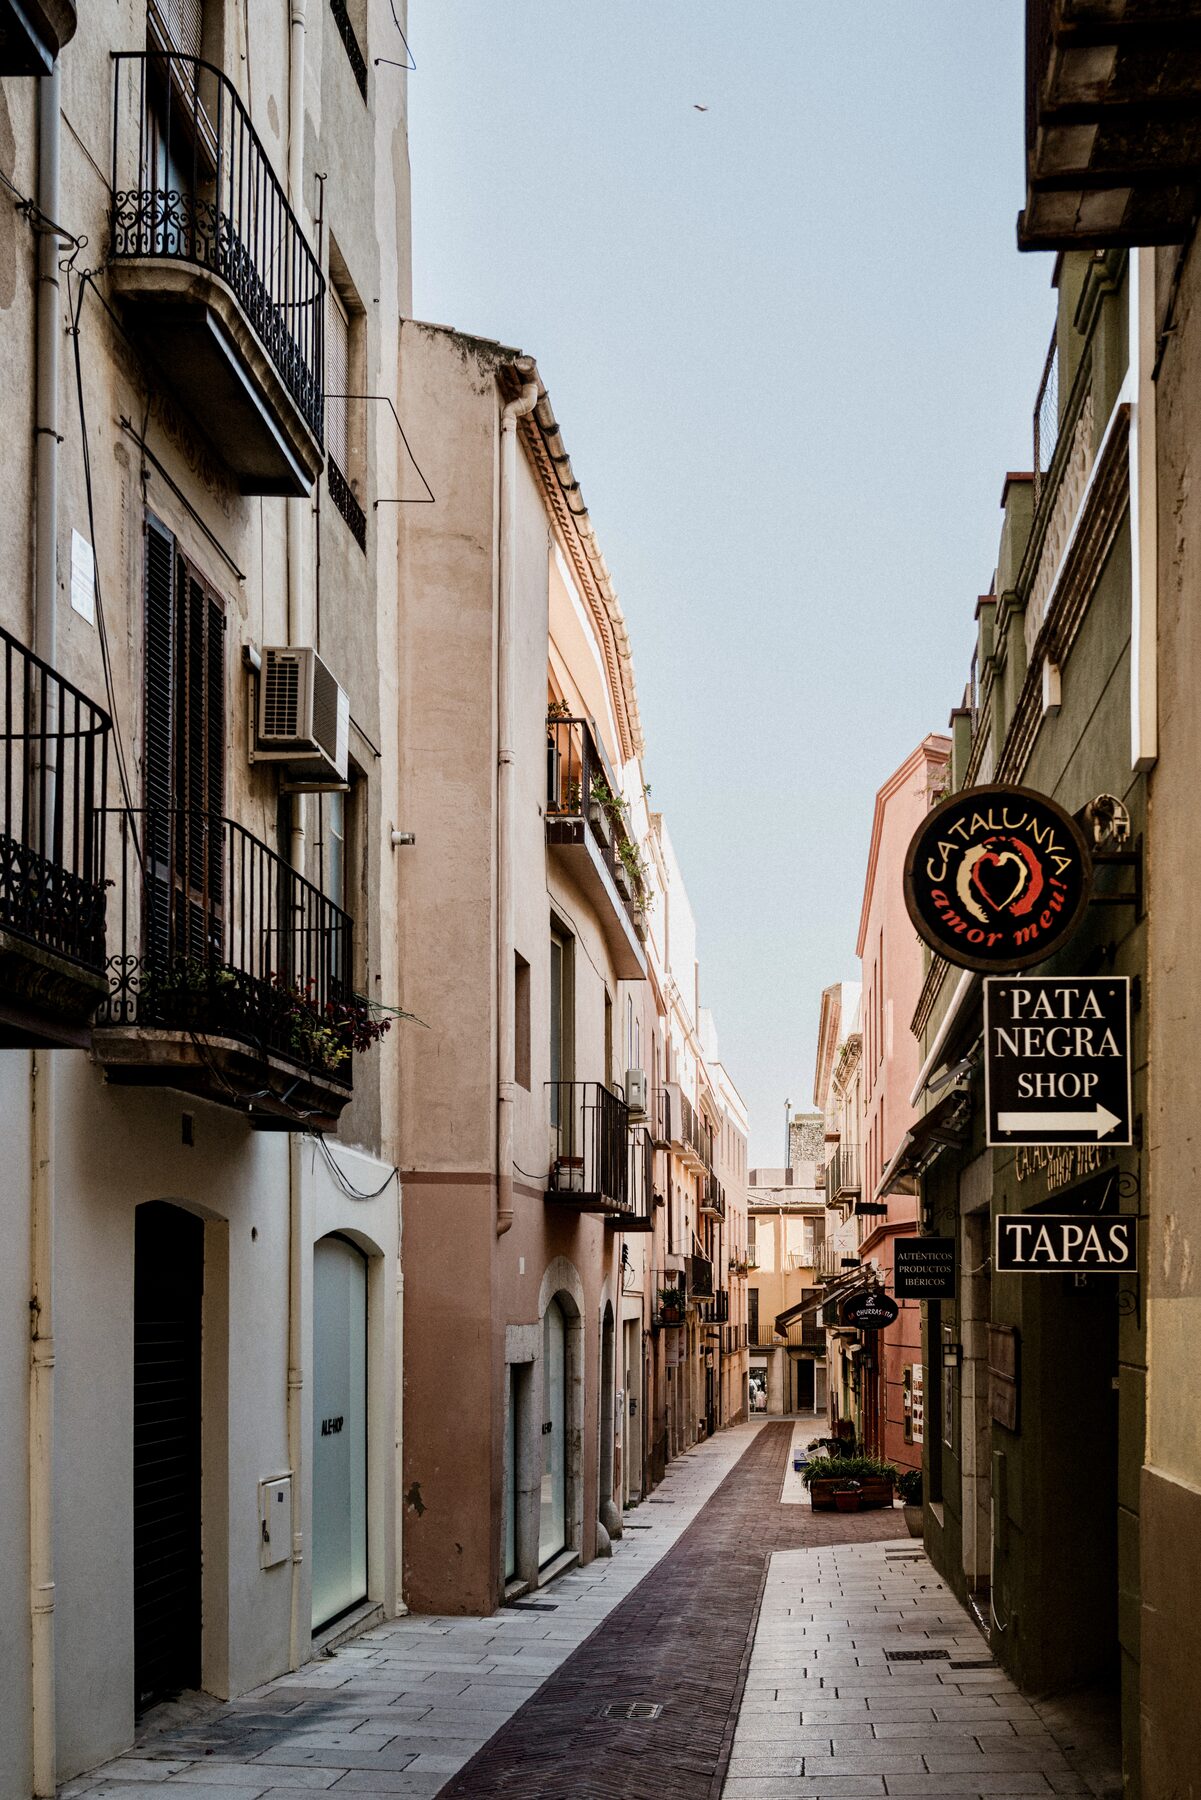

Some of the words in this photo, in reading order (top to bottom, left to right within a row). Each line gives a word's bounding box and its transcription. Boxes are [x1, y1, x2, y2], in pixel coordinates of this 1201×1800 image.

[926, 807, 1072, 882] CATALUNYA
[930, 889, 1003, 947] amor
[1013, 877, 1068, 946] meu!
[1010, 988, 1106, 1019] PATA
[994, 1027, 1123, 1058] NEGRA
[1017, 1073, 1099, 1098] SHOP
[898, 1251, 953, 1260] AUTÉNTICOS
[1006, 1224, 1129, 1264] TAPAS
[899, 1265, 951, 1273] PRODUCTOS
[905, 1277, 946, 1286] IBÉRICOS
